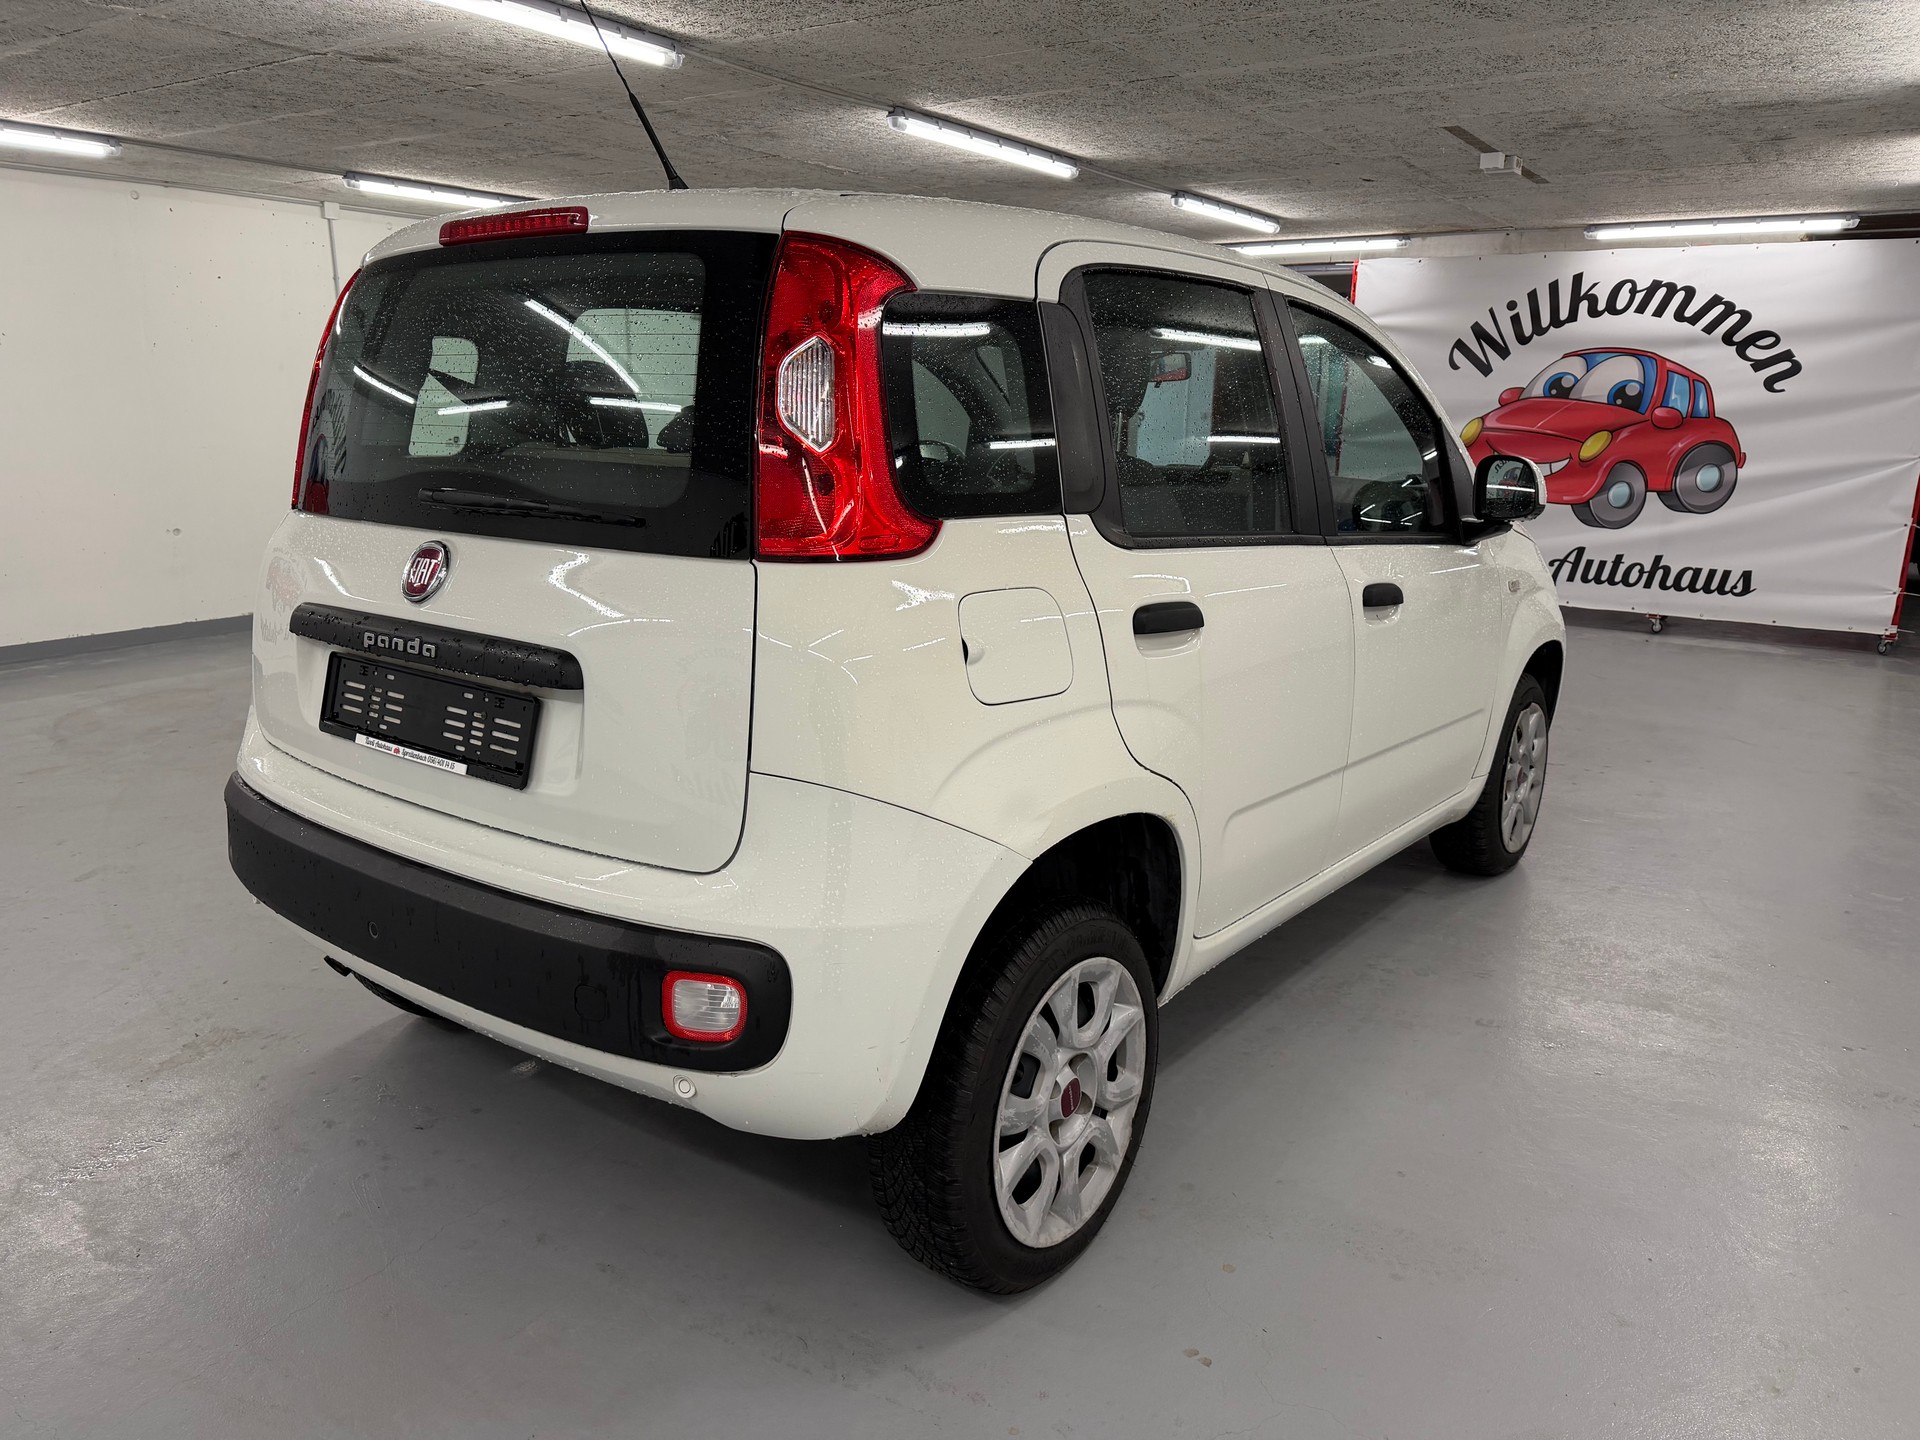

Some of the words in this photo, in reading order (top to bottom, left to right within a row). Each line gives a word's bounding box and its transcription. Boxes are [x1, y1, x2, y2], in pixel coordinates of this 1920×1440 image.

[1448, 271, 1803, 394] Willkommen
[408, 557, 440, 586] FIAT
[1548, 546, 1757, 597] Autohaus
[363, 631, 436, 658] panda
